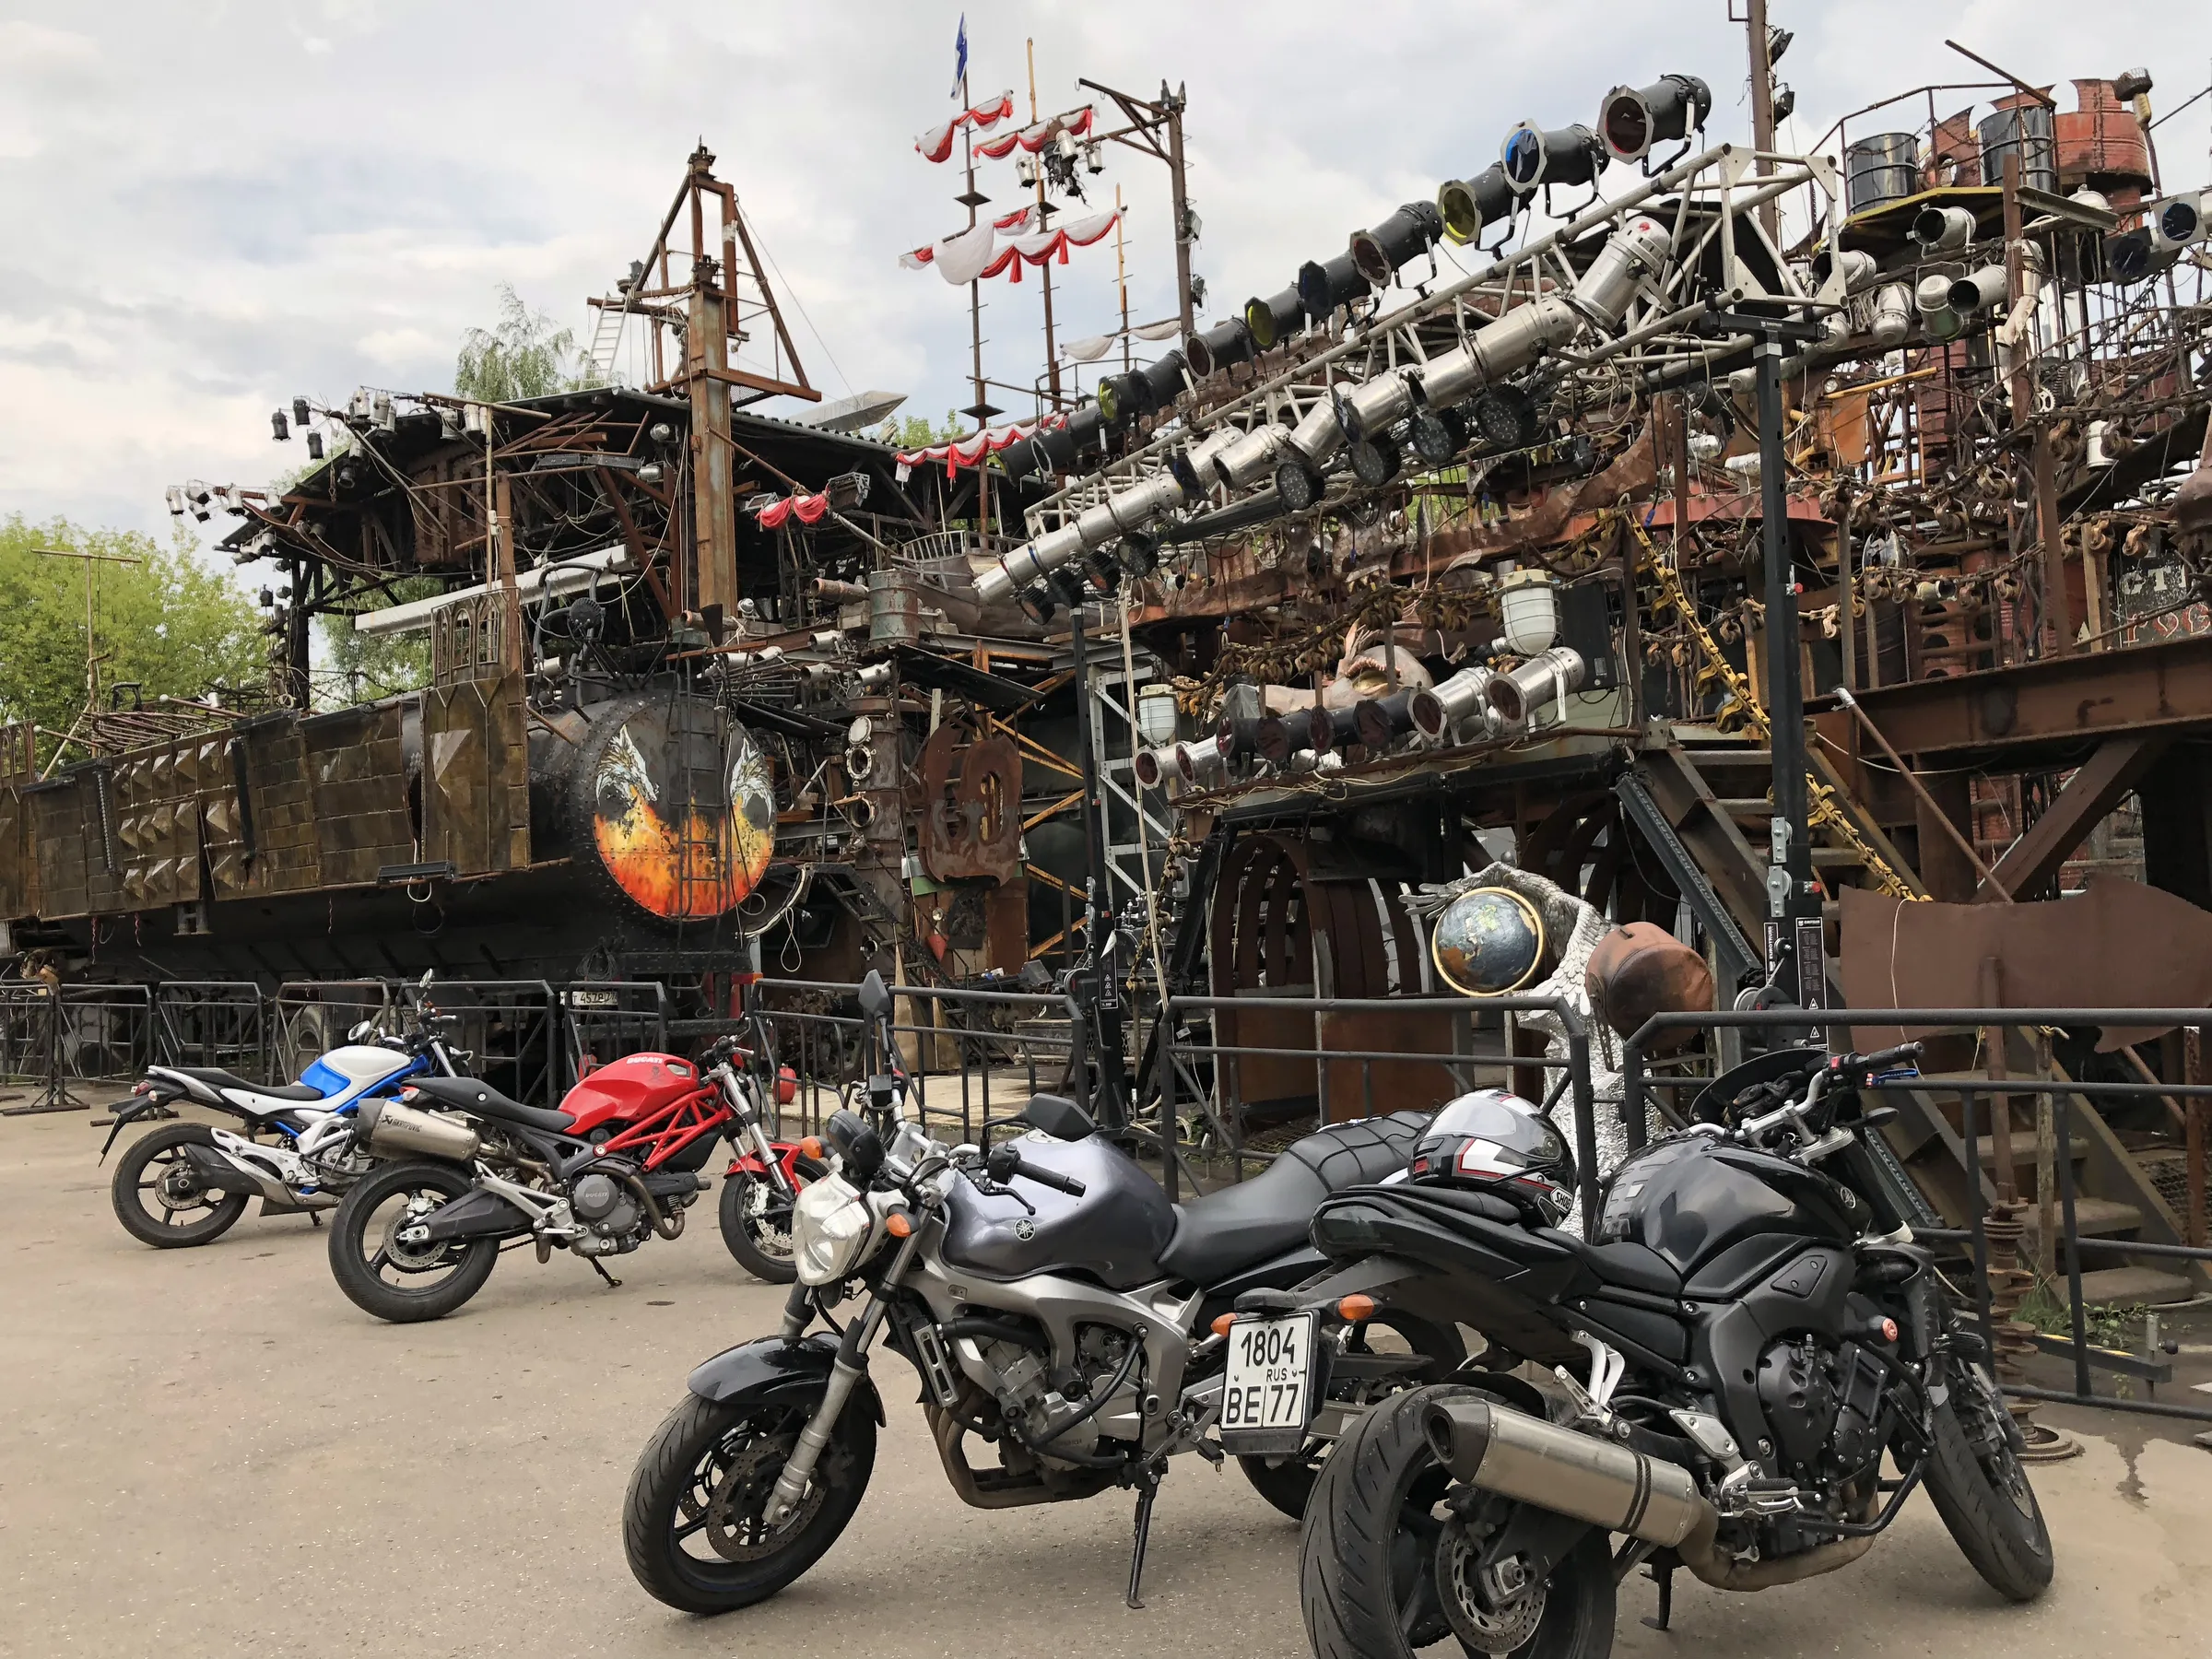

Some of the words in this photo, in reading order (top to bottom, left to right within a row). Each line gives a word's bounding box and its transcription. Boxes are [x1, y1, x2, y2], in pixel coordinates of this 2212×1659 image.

[626, 1056, 664, 1065] DUCATI
[1241, 1326, 1295, 1368] 1804
[1265, 1368, 1288, 1382] RUS
[1269, 1383, 1299, 1423] 77
